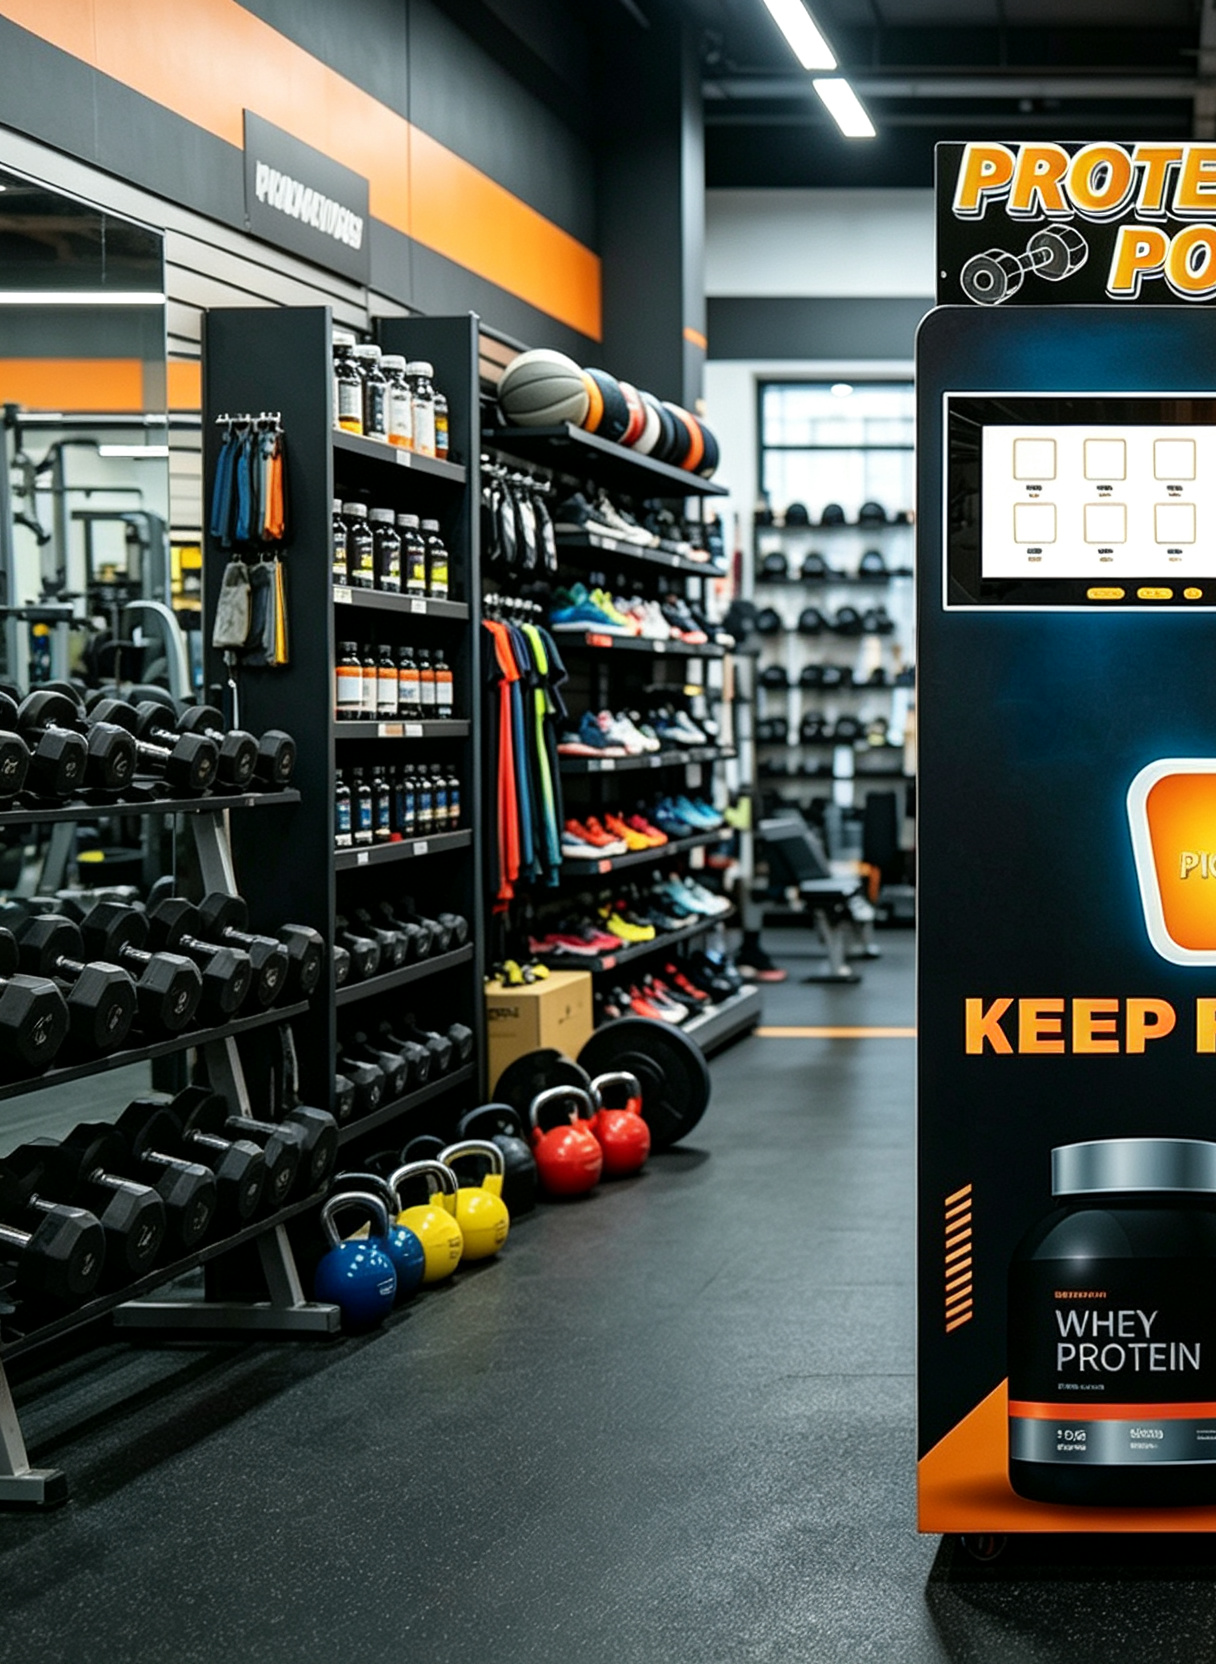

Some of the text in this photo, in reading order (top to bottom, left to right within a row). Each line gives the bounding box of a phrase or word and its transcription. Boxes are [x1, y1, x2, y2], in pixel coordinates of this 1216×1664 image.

[965, 998, 1176, 1054] KEEP
[1055, 1310, 1158, 1338] WHEY
[1057, 1342, 1200, 1372] PROTEIN
